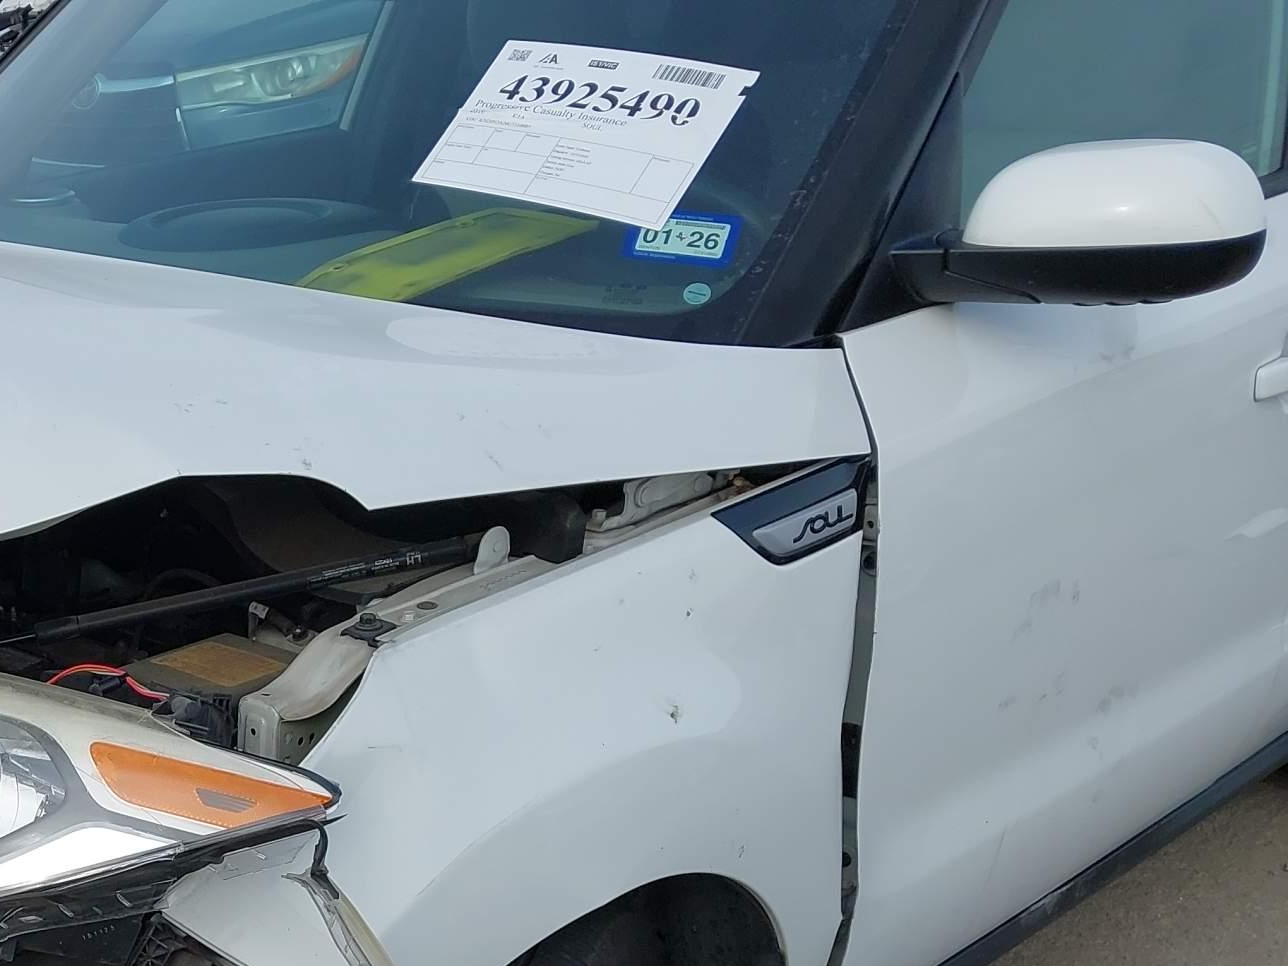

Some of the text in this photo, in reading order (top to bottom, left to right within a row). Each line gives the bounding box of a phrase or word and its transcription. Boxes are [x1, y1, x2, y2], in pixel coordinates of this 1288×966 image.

[475, 99, 531, 112] Progressive
[532, 105, 576, 120] Casualty
[578, 112, 628, 126] Insurance
[499, 75, 702, 126] 43925490
[642, 228, 721, 250] 01 26
[792, 505, 854, 543] SOUL
